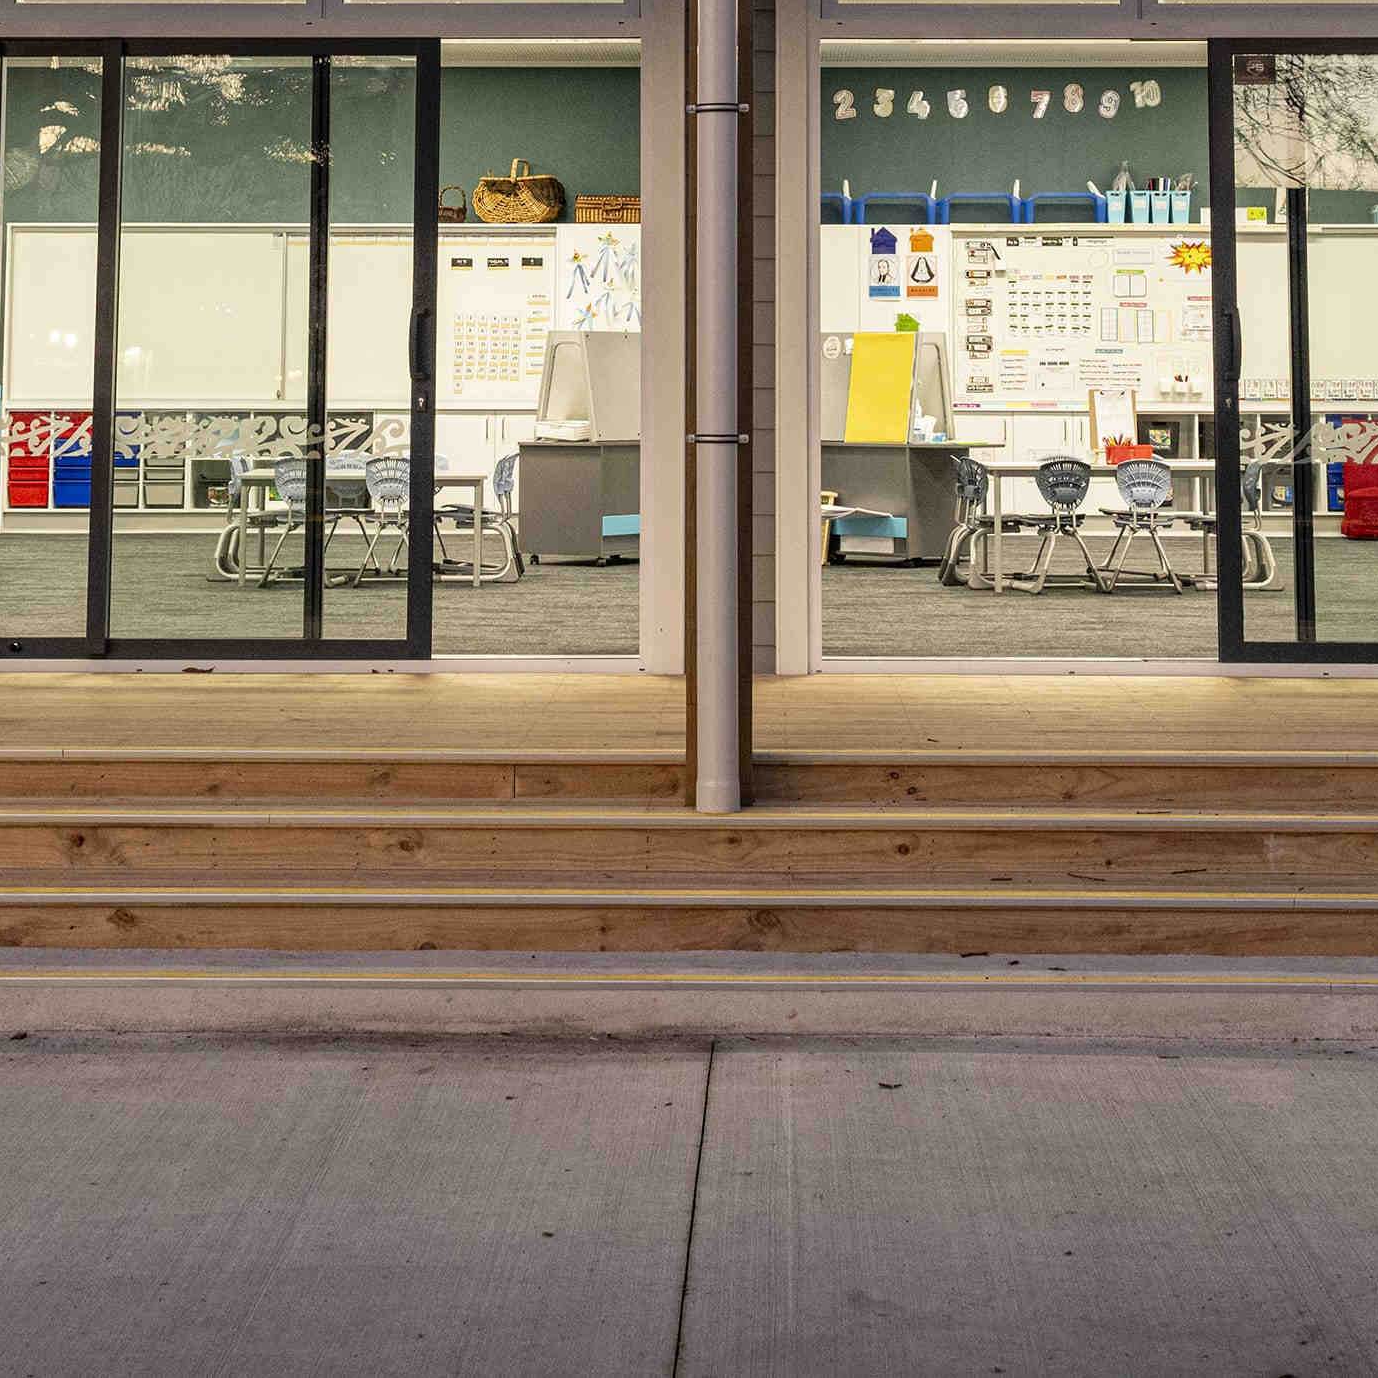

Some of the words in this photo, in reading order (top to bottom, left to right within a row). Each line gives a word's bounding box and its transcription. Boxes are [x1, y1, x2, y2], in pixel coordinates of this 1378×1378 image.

[832, 89, 857, 120] 2
[873, 88, 896, 118] 3
[907, 90, 931, 120] 4
[946, 89, 969, 119] 5
[1030, 90, 1052, 119] 7
[1063, 83, 1085, 113] 8
[1098, 89, 1121, 119] 9
[1129, 79, 1162, 109] 10
